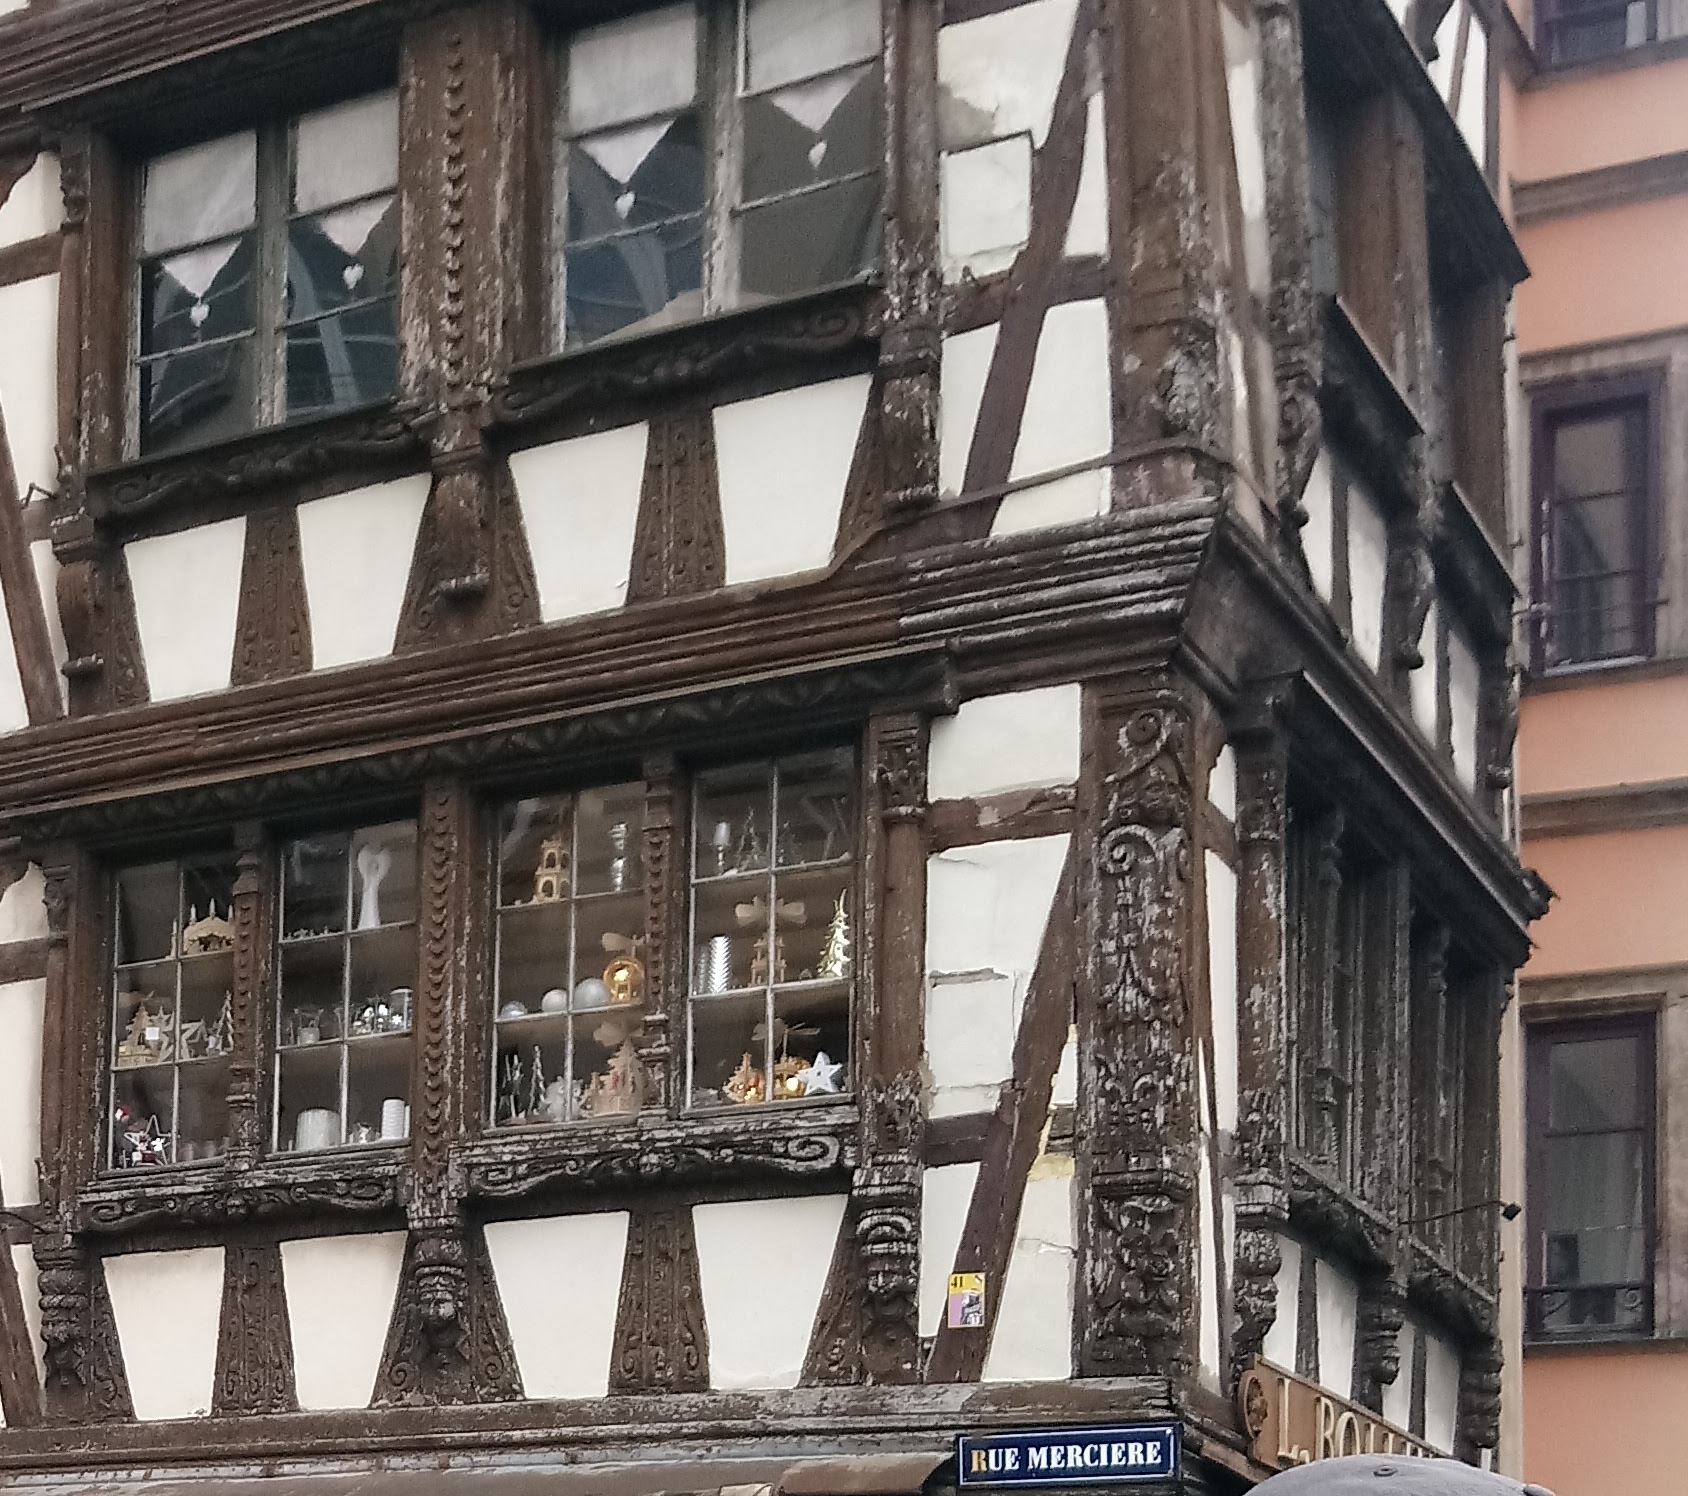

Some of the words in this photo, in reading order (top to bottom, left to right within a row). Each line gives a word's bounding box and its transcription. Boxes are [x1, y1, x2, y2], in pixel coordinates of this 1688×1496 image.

[950, 1276, 964, 1288] 41
[970, 1447, 1020, 1473] RUE
[1027, 1441, 1162, 1470] MERCIERE
